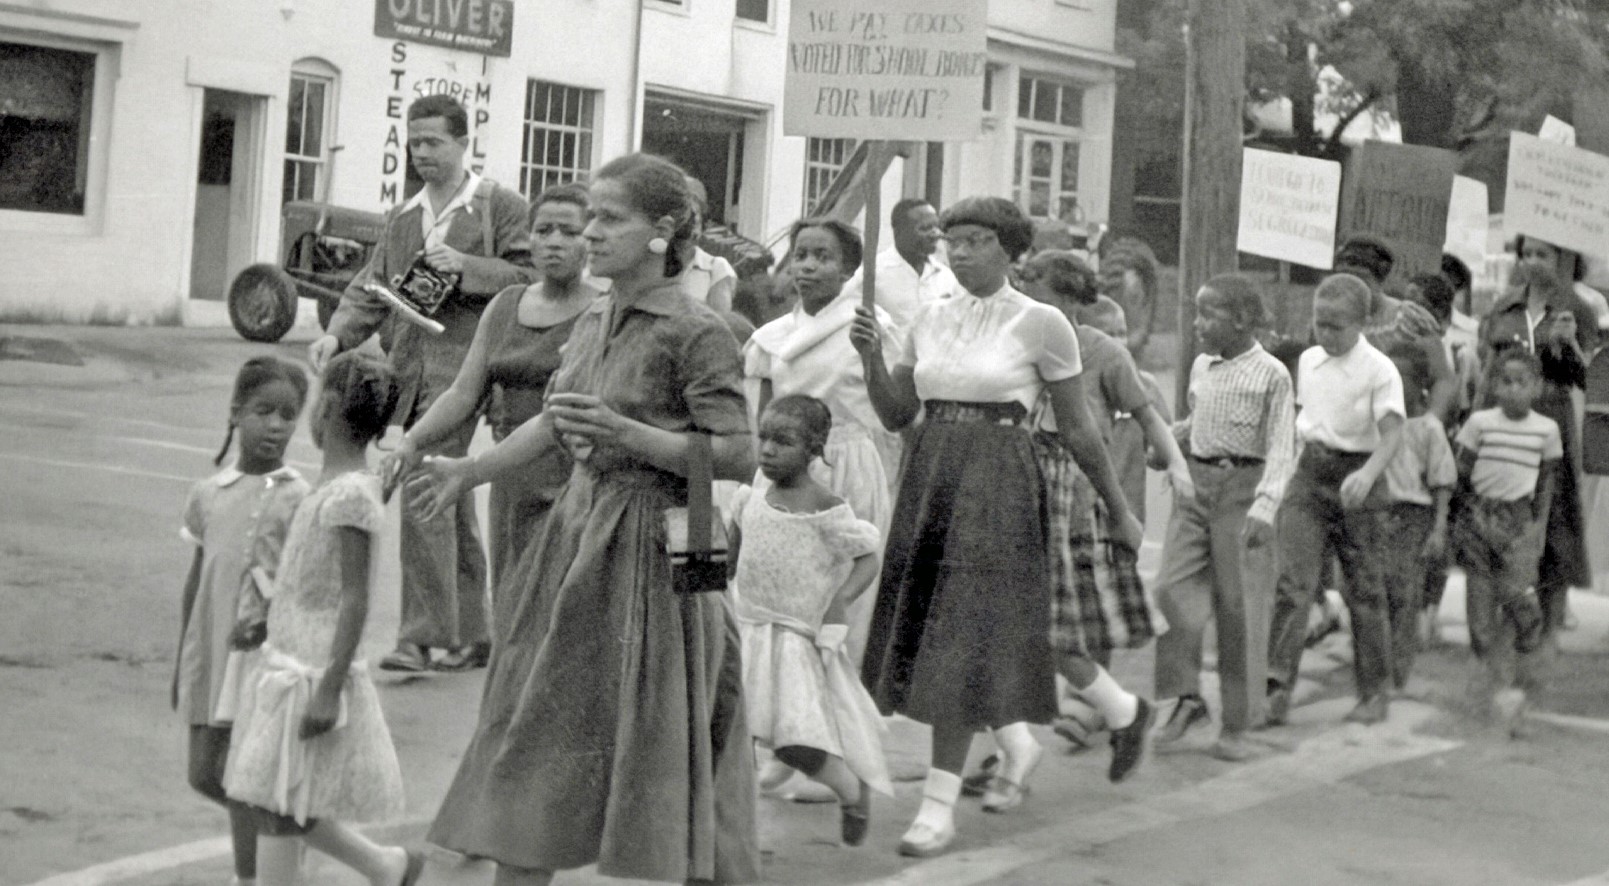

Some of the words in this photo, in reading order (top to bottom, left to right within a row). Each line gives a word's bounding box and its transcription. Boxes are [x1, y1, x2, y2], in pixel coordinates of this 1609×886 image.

[809, 11, 838, 33] WE
[850, 12, 888, 34] PAY
[413, 78, 473, 105] STORE
[815, 87, 859, 117] FOR
[869, 88, 950, 120] WHAT?
